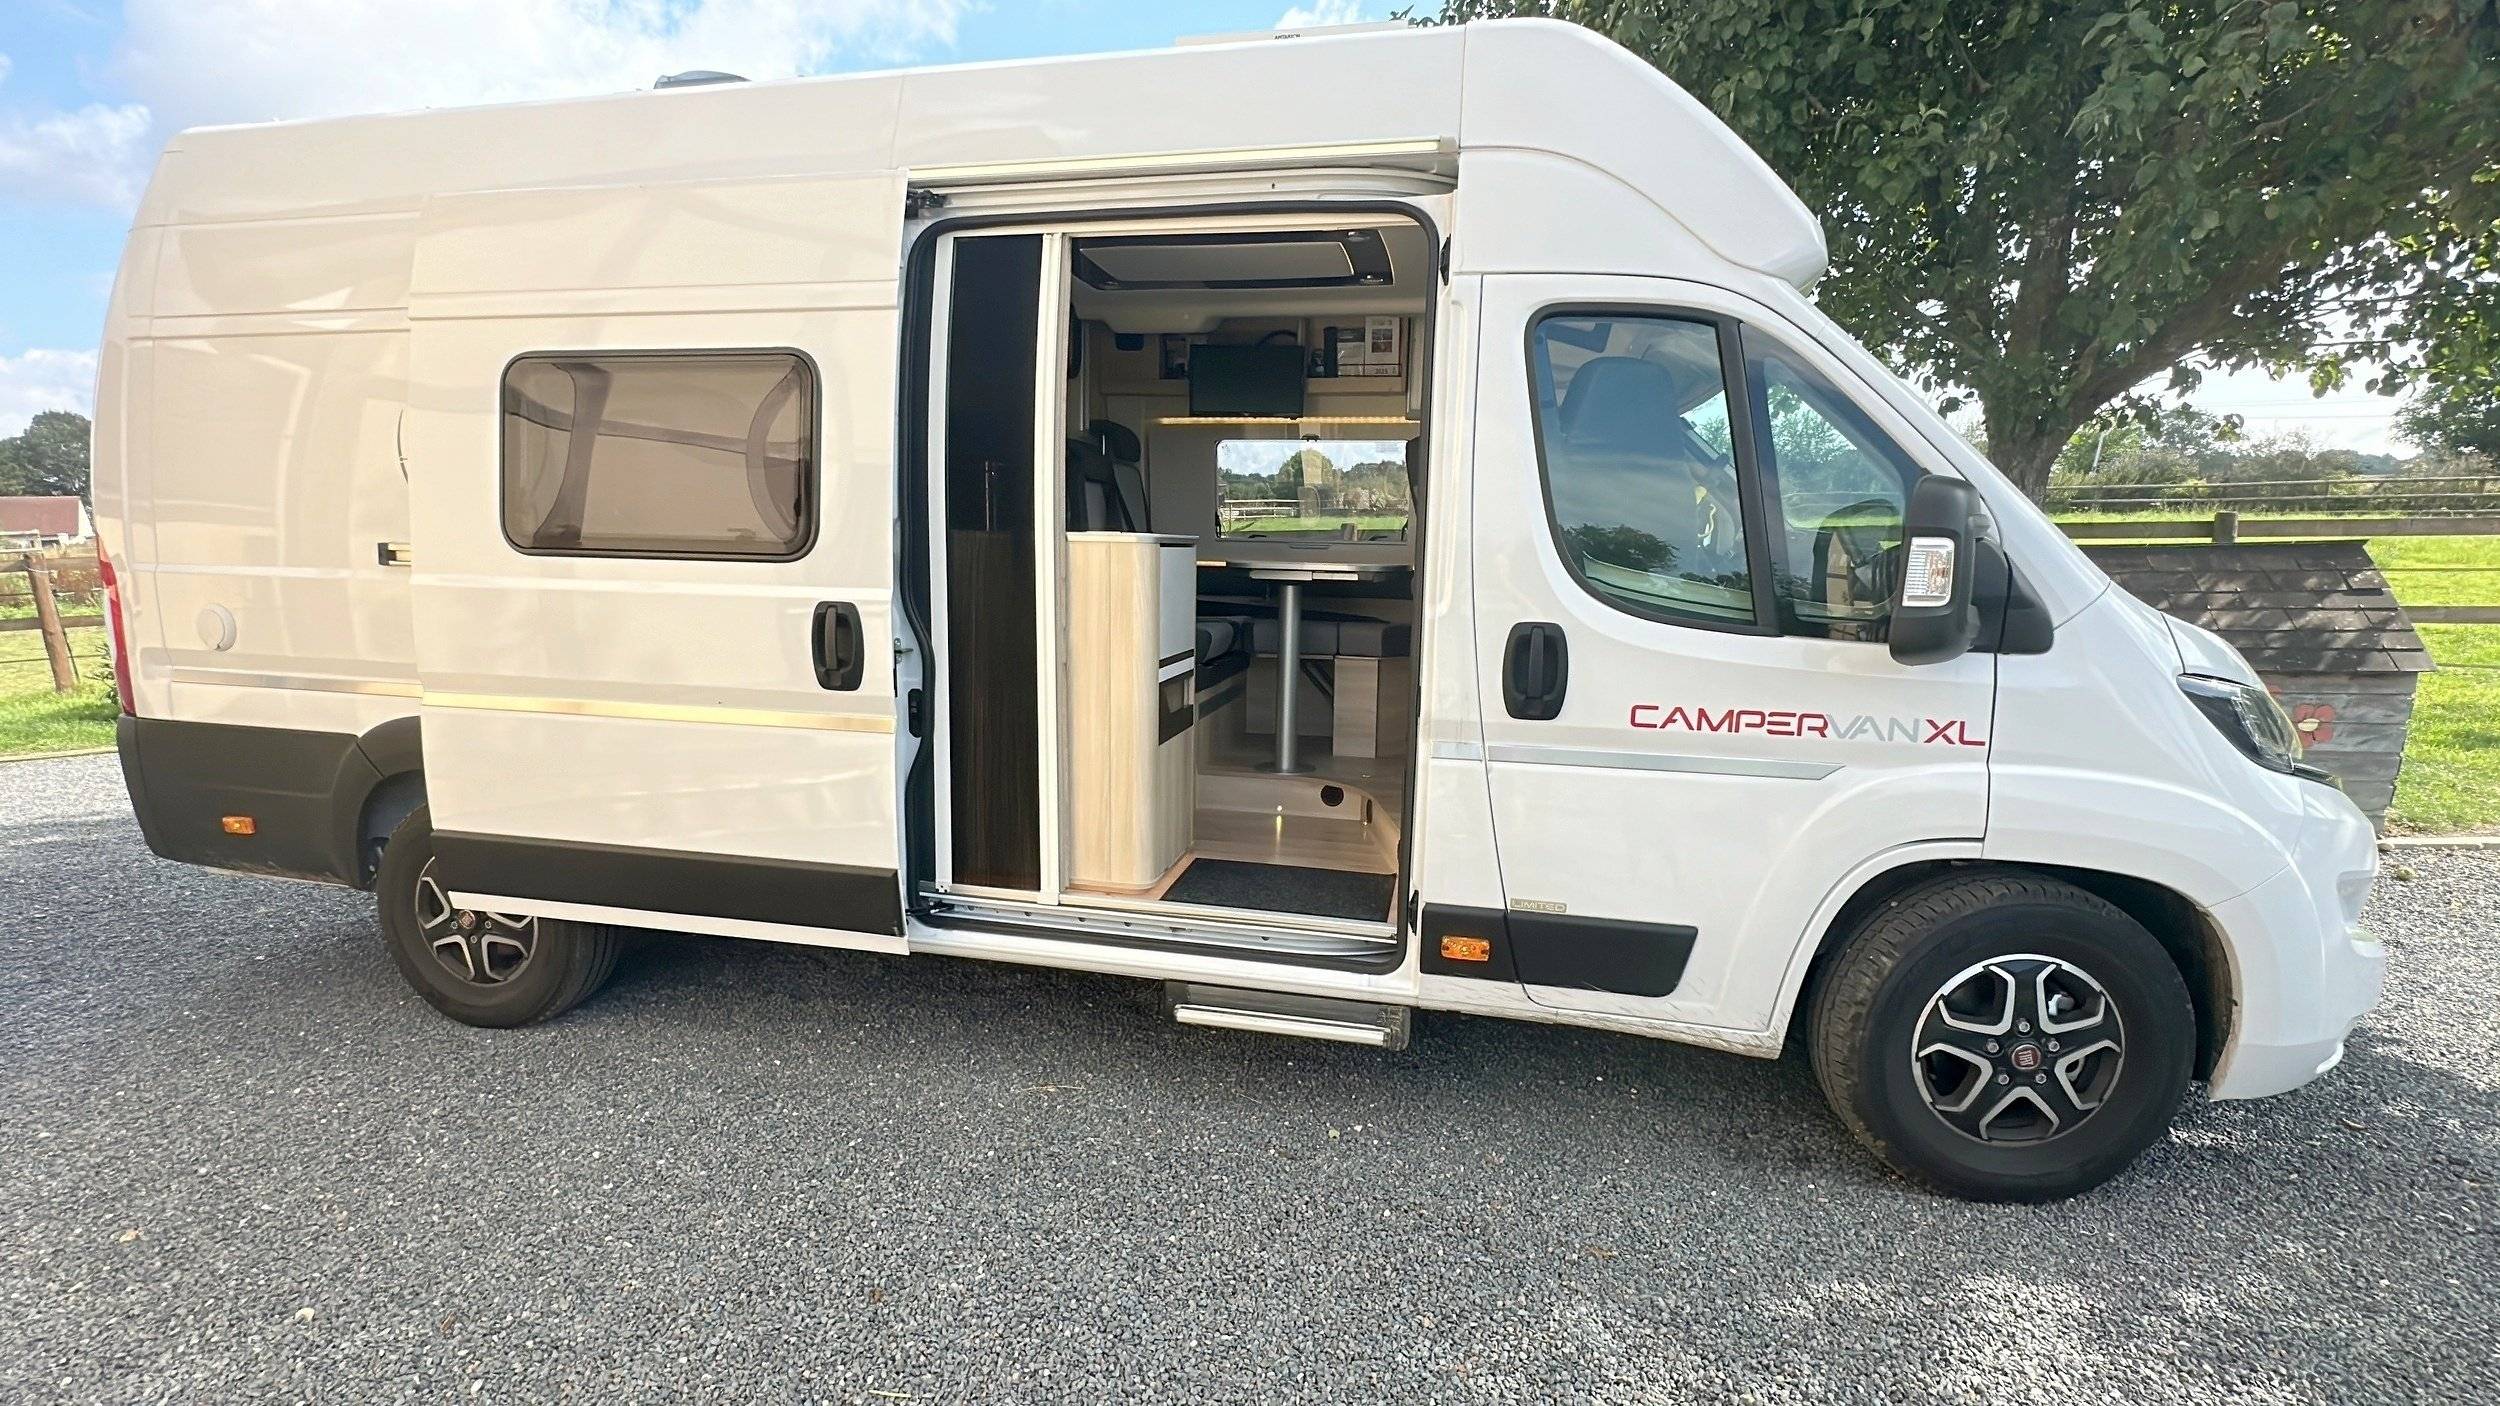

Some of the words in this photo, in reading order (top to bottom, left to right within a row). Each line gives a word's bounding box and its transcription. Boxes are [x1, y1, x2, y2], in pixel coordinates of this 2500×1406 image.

[1630, 704, 1986, 747] CAMPERVANXL
[1511, 899, 1566, 912] LIMITED
[2018, 1050, 2034, 1066] FIAT
